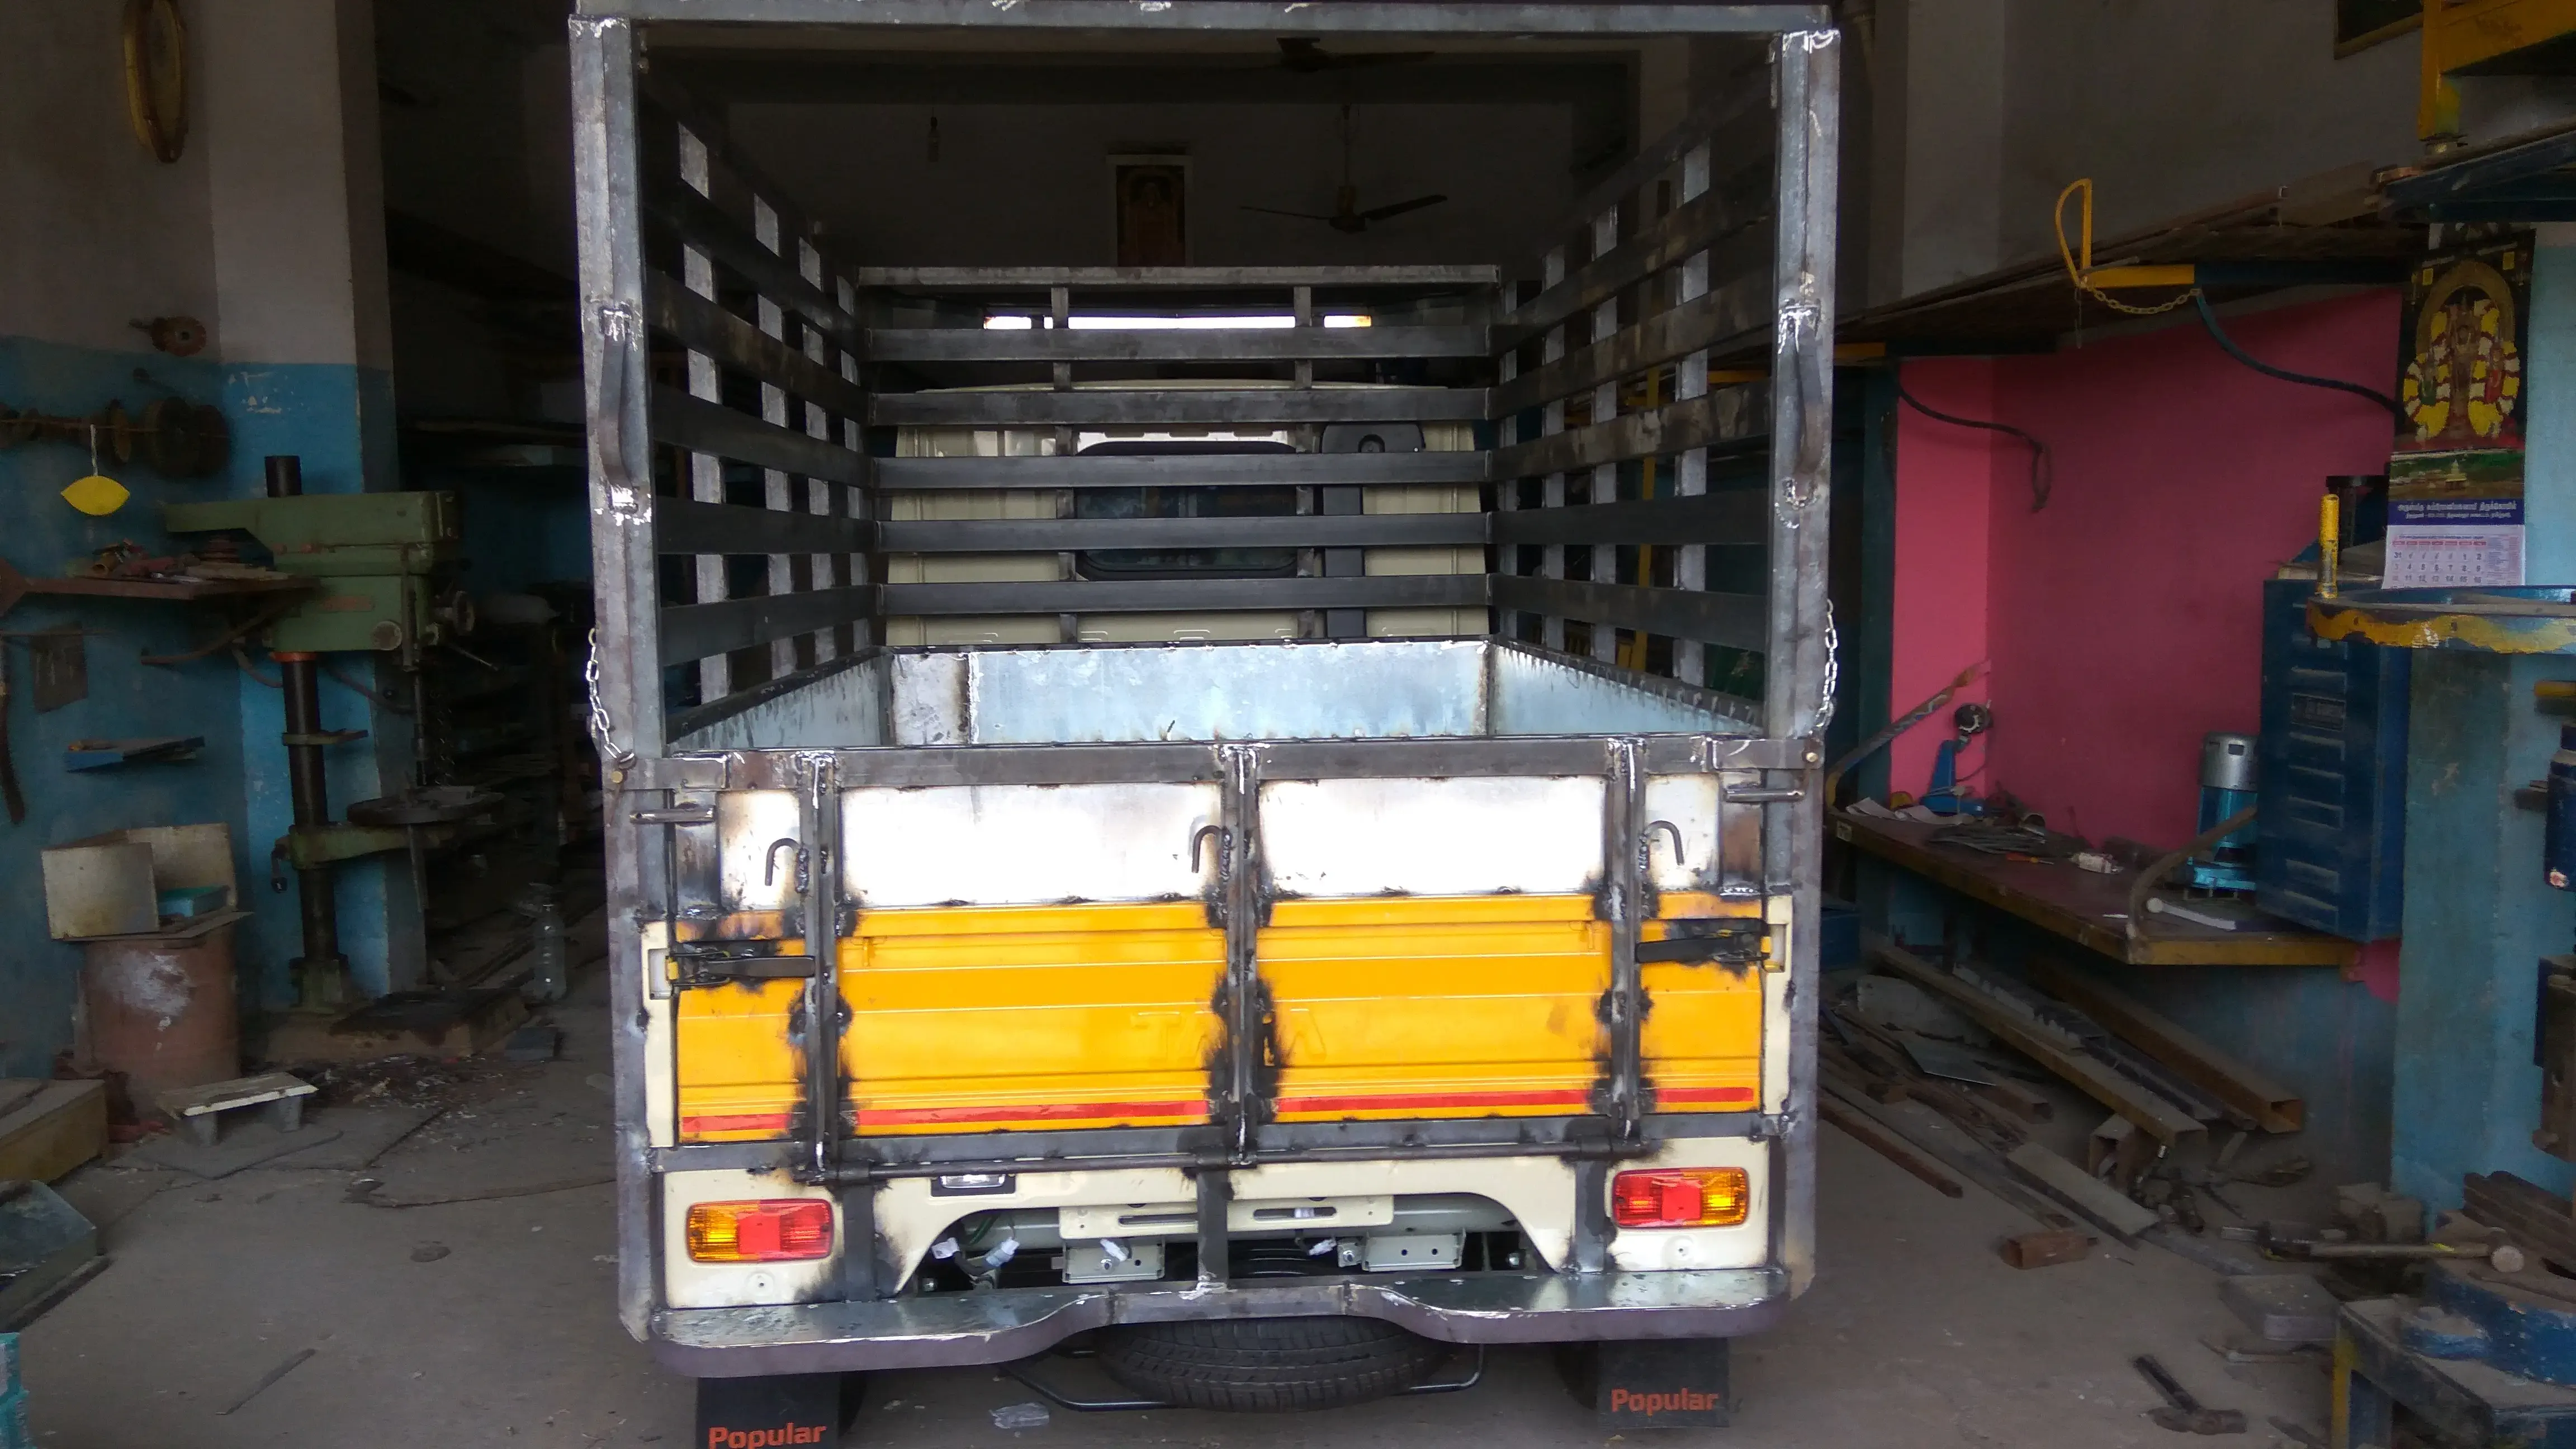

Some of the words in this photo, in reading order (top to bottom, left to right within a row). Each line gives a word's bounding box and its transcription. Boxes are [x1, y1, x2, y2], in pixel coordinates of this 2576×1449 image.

[1129, 1008, 1327, 1063] TAA
[1611, 1388, 1719, 1417] Popular
[708, 1422, 827, 1449] Popular
